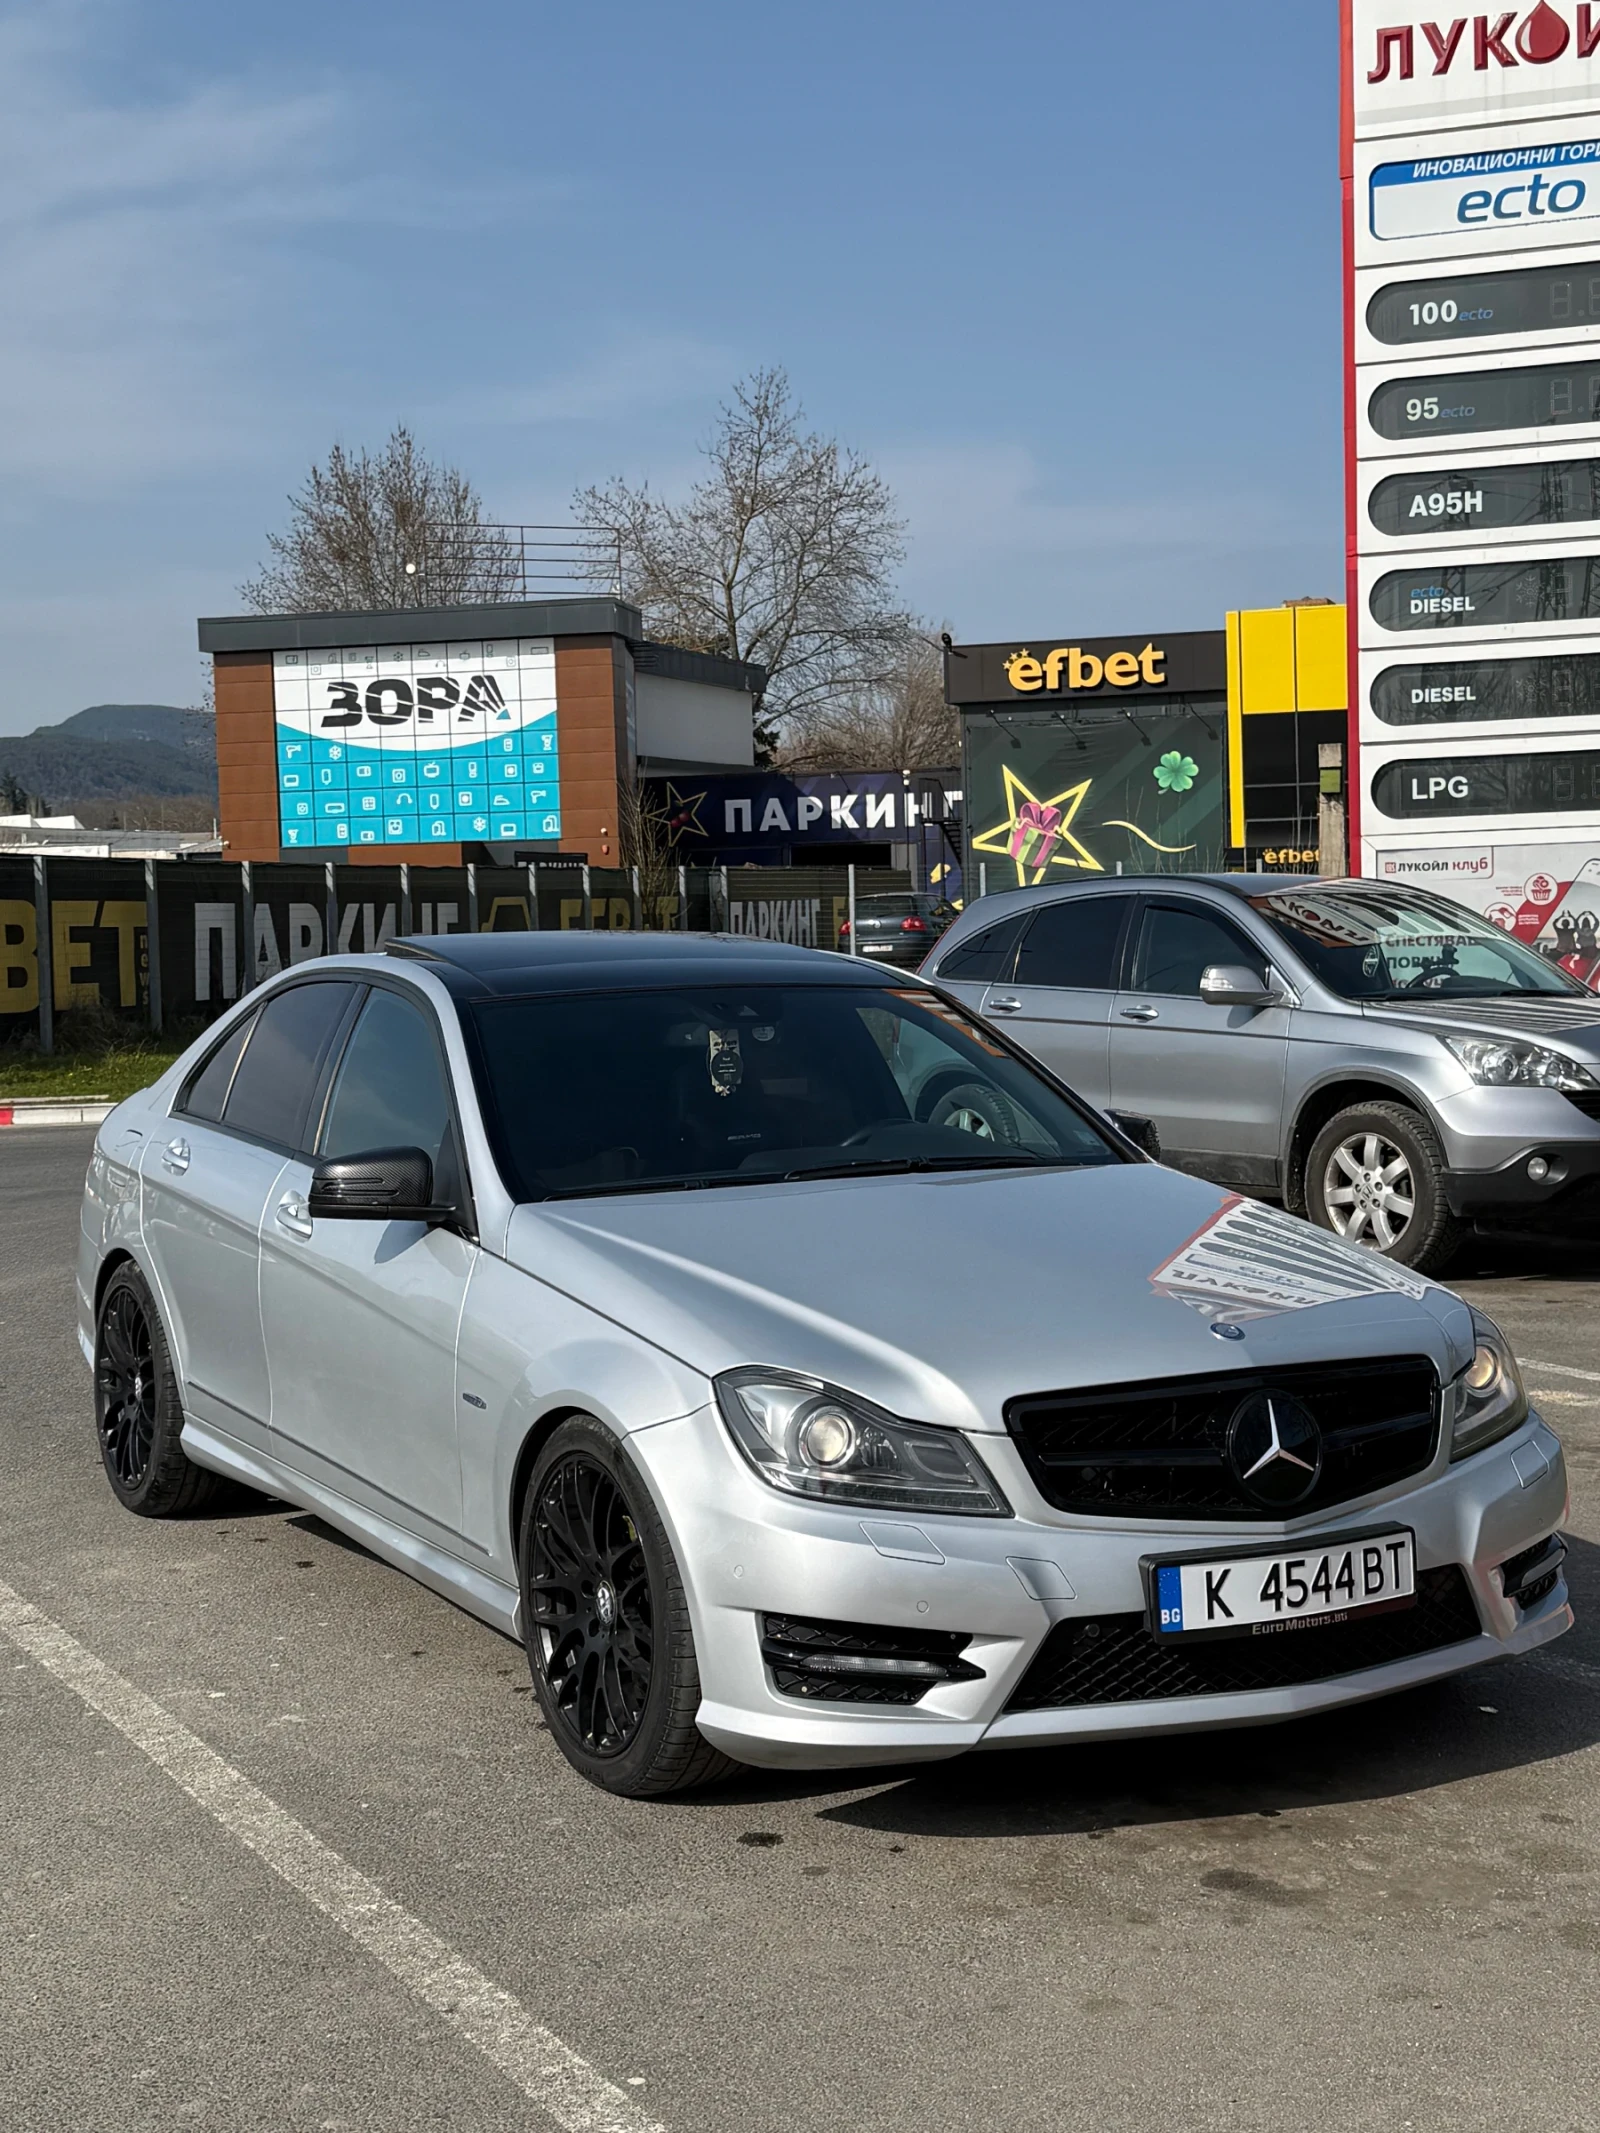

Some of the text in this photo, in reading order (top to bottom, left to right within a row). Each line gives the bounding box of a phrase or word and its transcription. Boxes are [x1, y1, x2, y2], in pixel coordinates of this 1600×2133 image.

[1412, 147, 1556, 178] ИНОВАЦИОННИ
[1457, 173, 1586, 223] ecto
[1409, 299, 1493, 325] 100 ecto
[1406, 397, 1440, 421] 95
[1409, 490, 1483, 517] A95H
[1410, 586, 1444, 598] ecto
[1410, 596, 1475, 614] DIESEL
[1007, 642, 1165, 691] efbet
[321, 673, 510, 727] ЗОРА
[1411, 686, 1476, 704] DIESEL
[1412, 775, 1469, 800] LPG
[1398, 860, 1448, 872] ЛУКОЙЛ
[1205, 1568, 1235, 1620] K
[1160, 1608, 1181, 1625] BG
